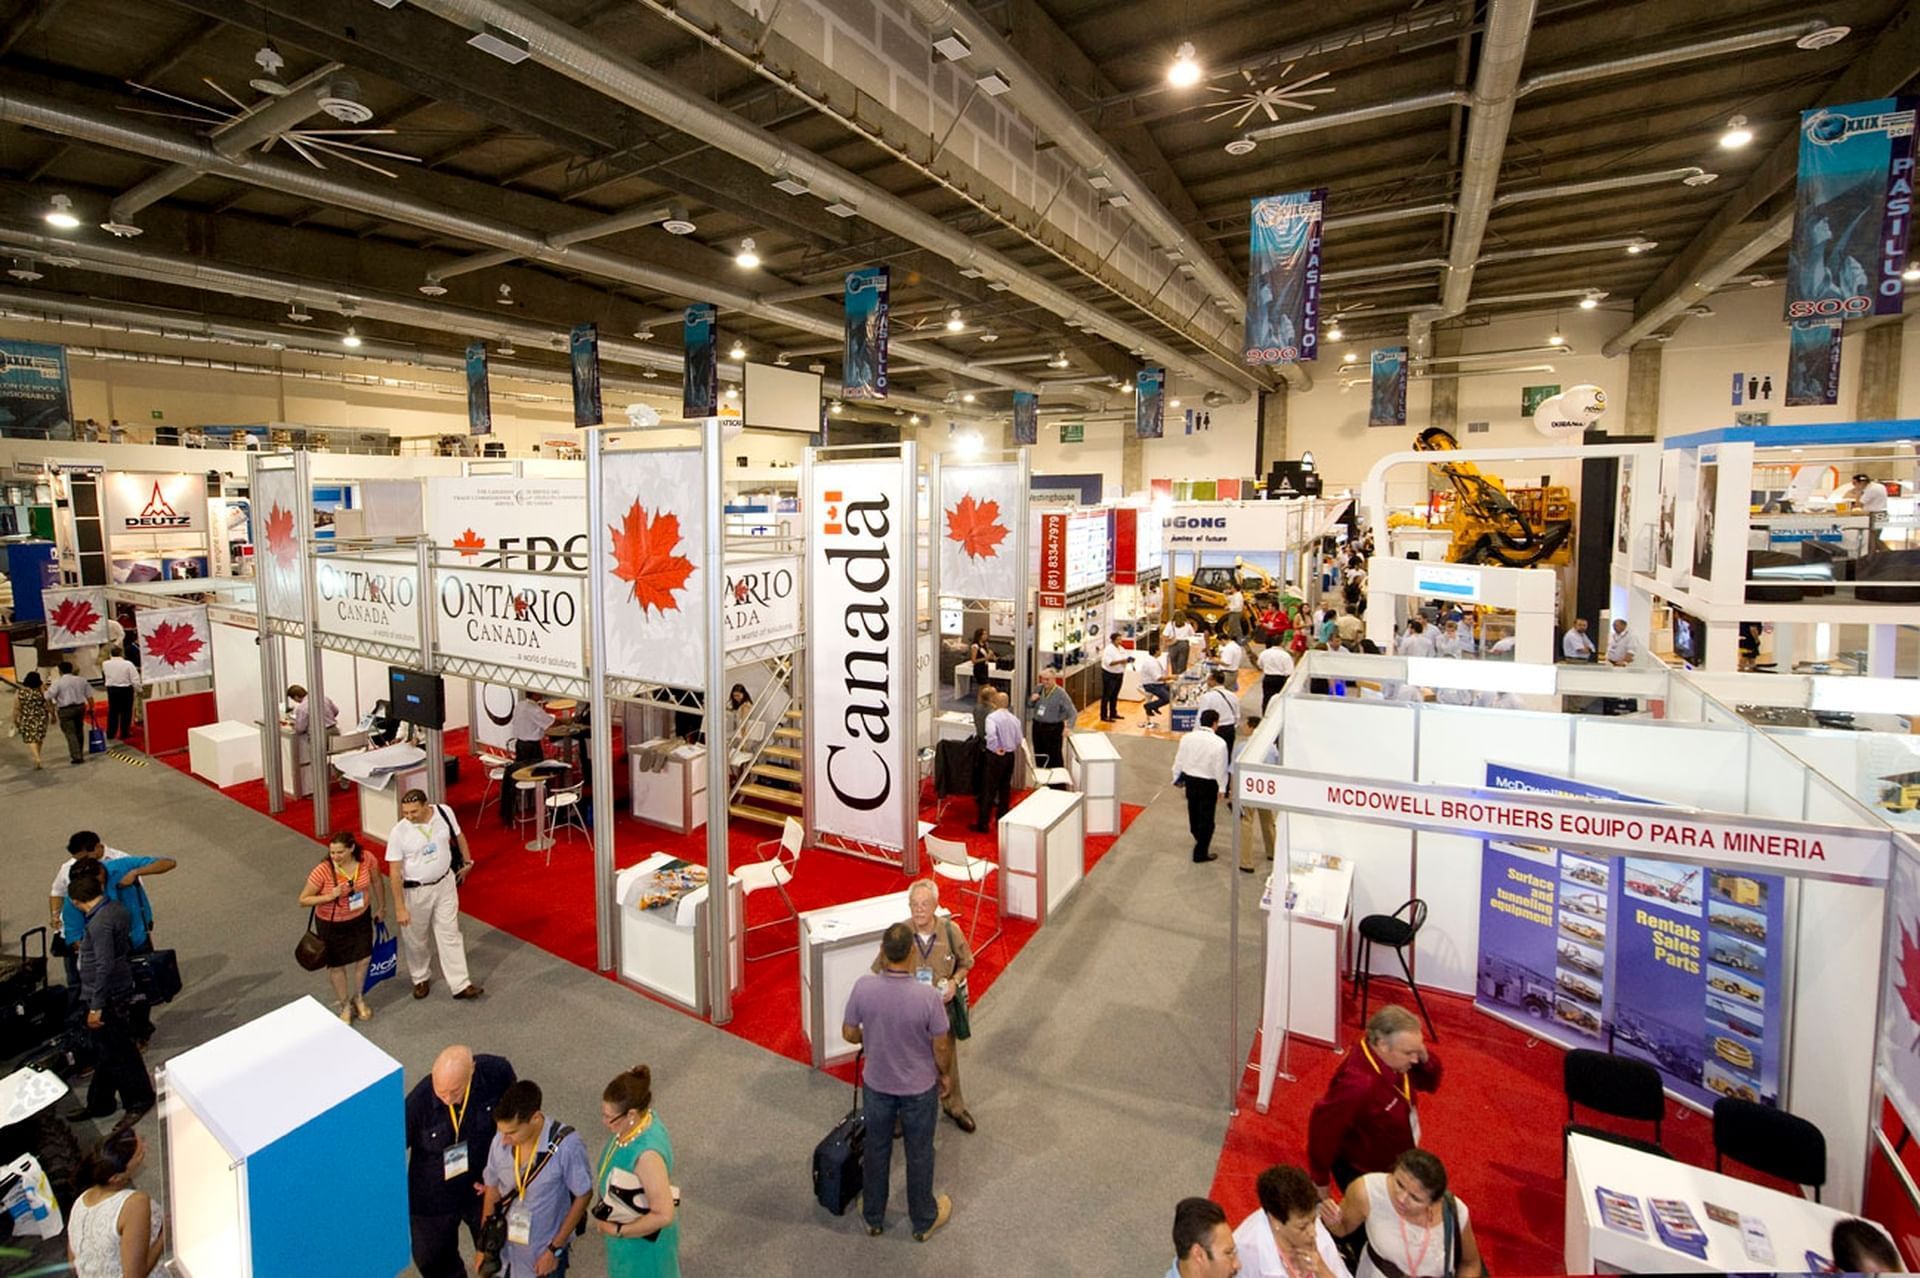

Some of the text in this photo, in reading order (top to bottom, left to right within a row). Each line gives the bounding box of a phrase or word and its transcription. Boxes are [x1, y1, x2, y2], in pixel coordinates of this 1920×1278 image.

[1879, 158, 1914, 296] PASILLO
[1302, 237, 1321, 347] PASILLO
[1788, 296, 1872, 318] 800
[125, 516, 191, 526] DEUTZ
[1047, 515, 1060, 568] 8334-7979
[319, 563, 414, 612] ONTARIO
[724, 568, 793, 608] ARIO
[337, 601, 390, 626] CANADA
[441, 574, 576, 633] ONTARIO
[466, 618, 542, 649] CANADA
[523, 654, 539, 664] world
[539, 655, 547, 664] of
[548, 656, 577, 669] solutions
[823, 492, 891, 811] Canada
[1245, 777, 1277, 796] 908
[1326, 786, 1827, 861] MCDOWELL BROTHERS EQUIPO PARA MINERIA
[1507, 867, 1555, 892] Surface
[1497, 887, 1553, 917] tunneling
[1531, 887, 1554, 904] and
[1490, 898, 1553, 928] equipment
[1635, 909, 1701, 943] Rentals
[1652, 930, 1700, 959] Sales
[1654, 946, 1700, 975] Parts
